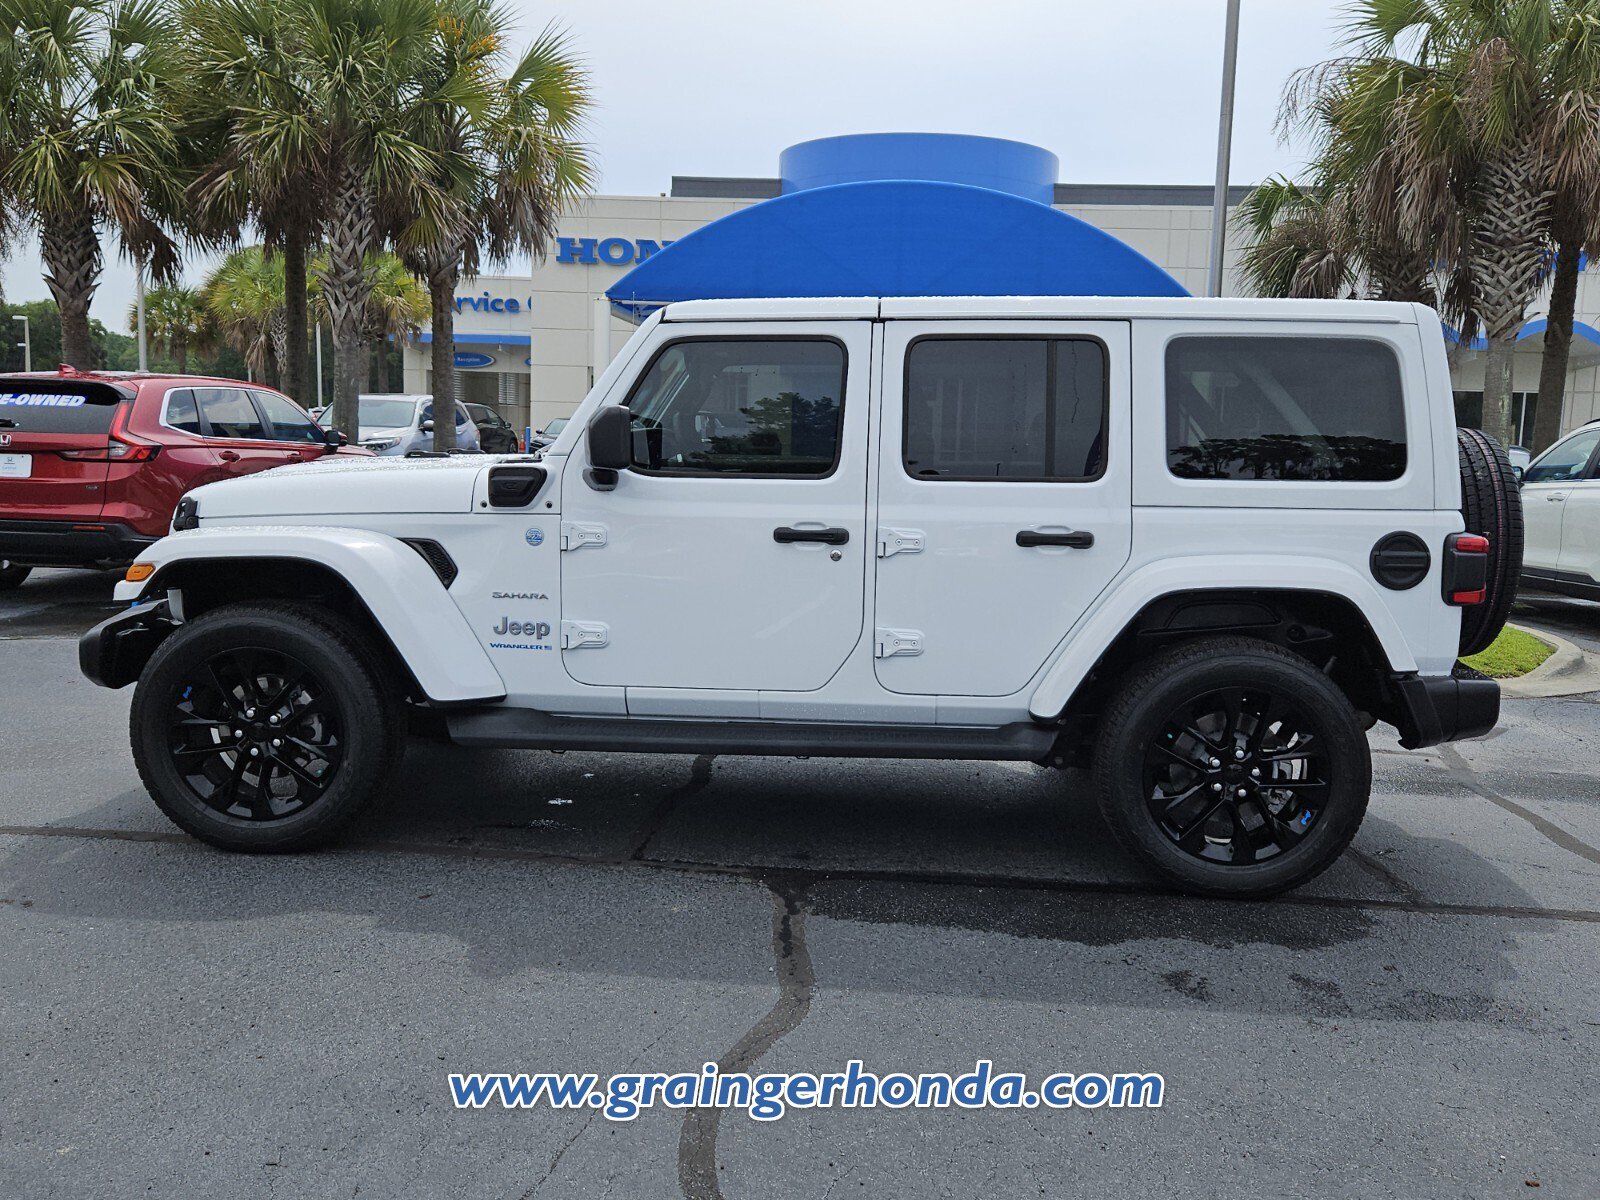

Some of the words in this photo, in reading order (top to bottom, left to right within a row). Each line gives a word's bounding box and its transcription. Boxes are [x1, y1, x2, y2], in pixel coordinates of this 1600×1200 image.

[451, 291, 521, 314] rvice
[0, 393, 86, 407] E-OWNED
[492, 591, 549, 600] SAHARA
[493, 616, 550, 640] Jeep
[489, 642, 543, 650] WRANGLER
